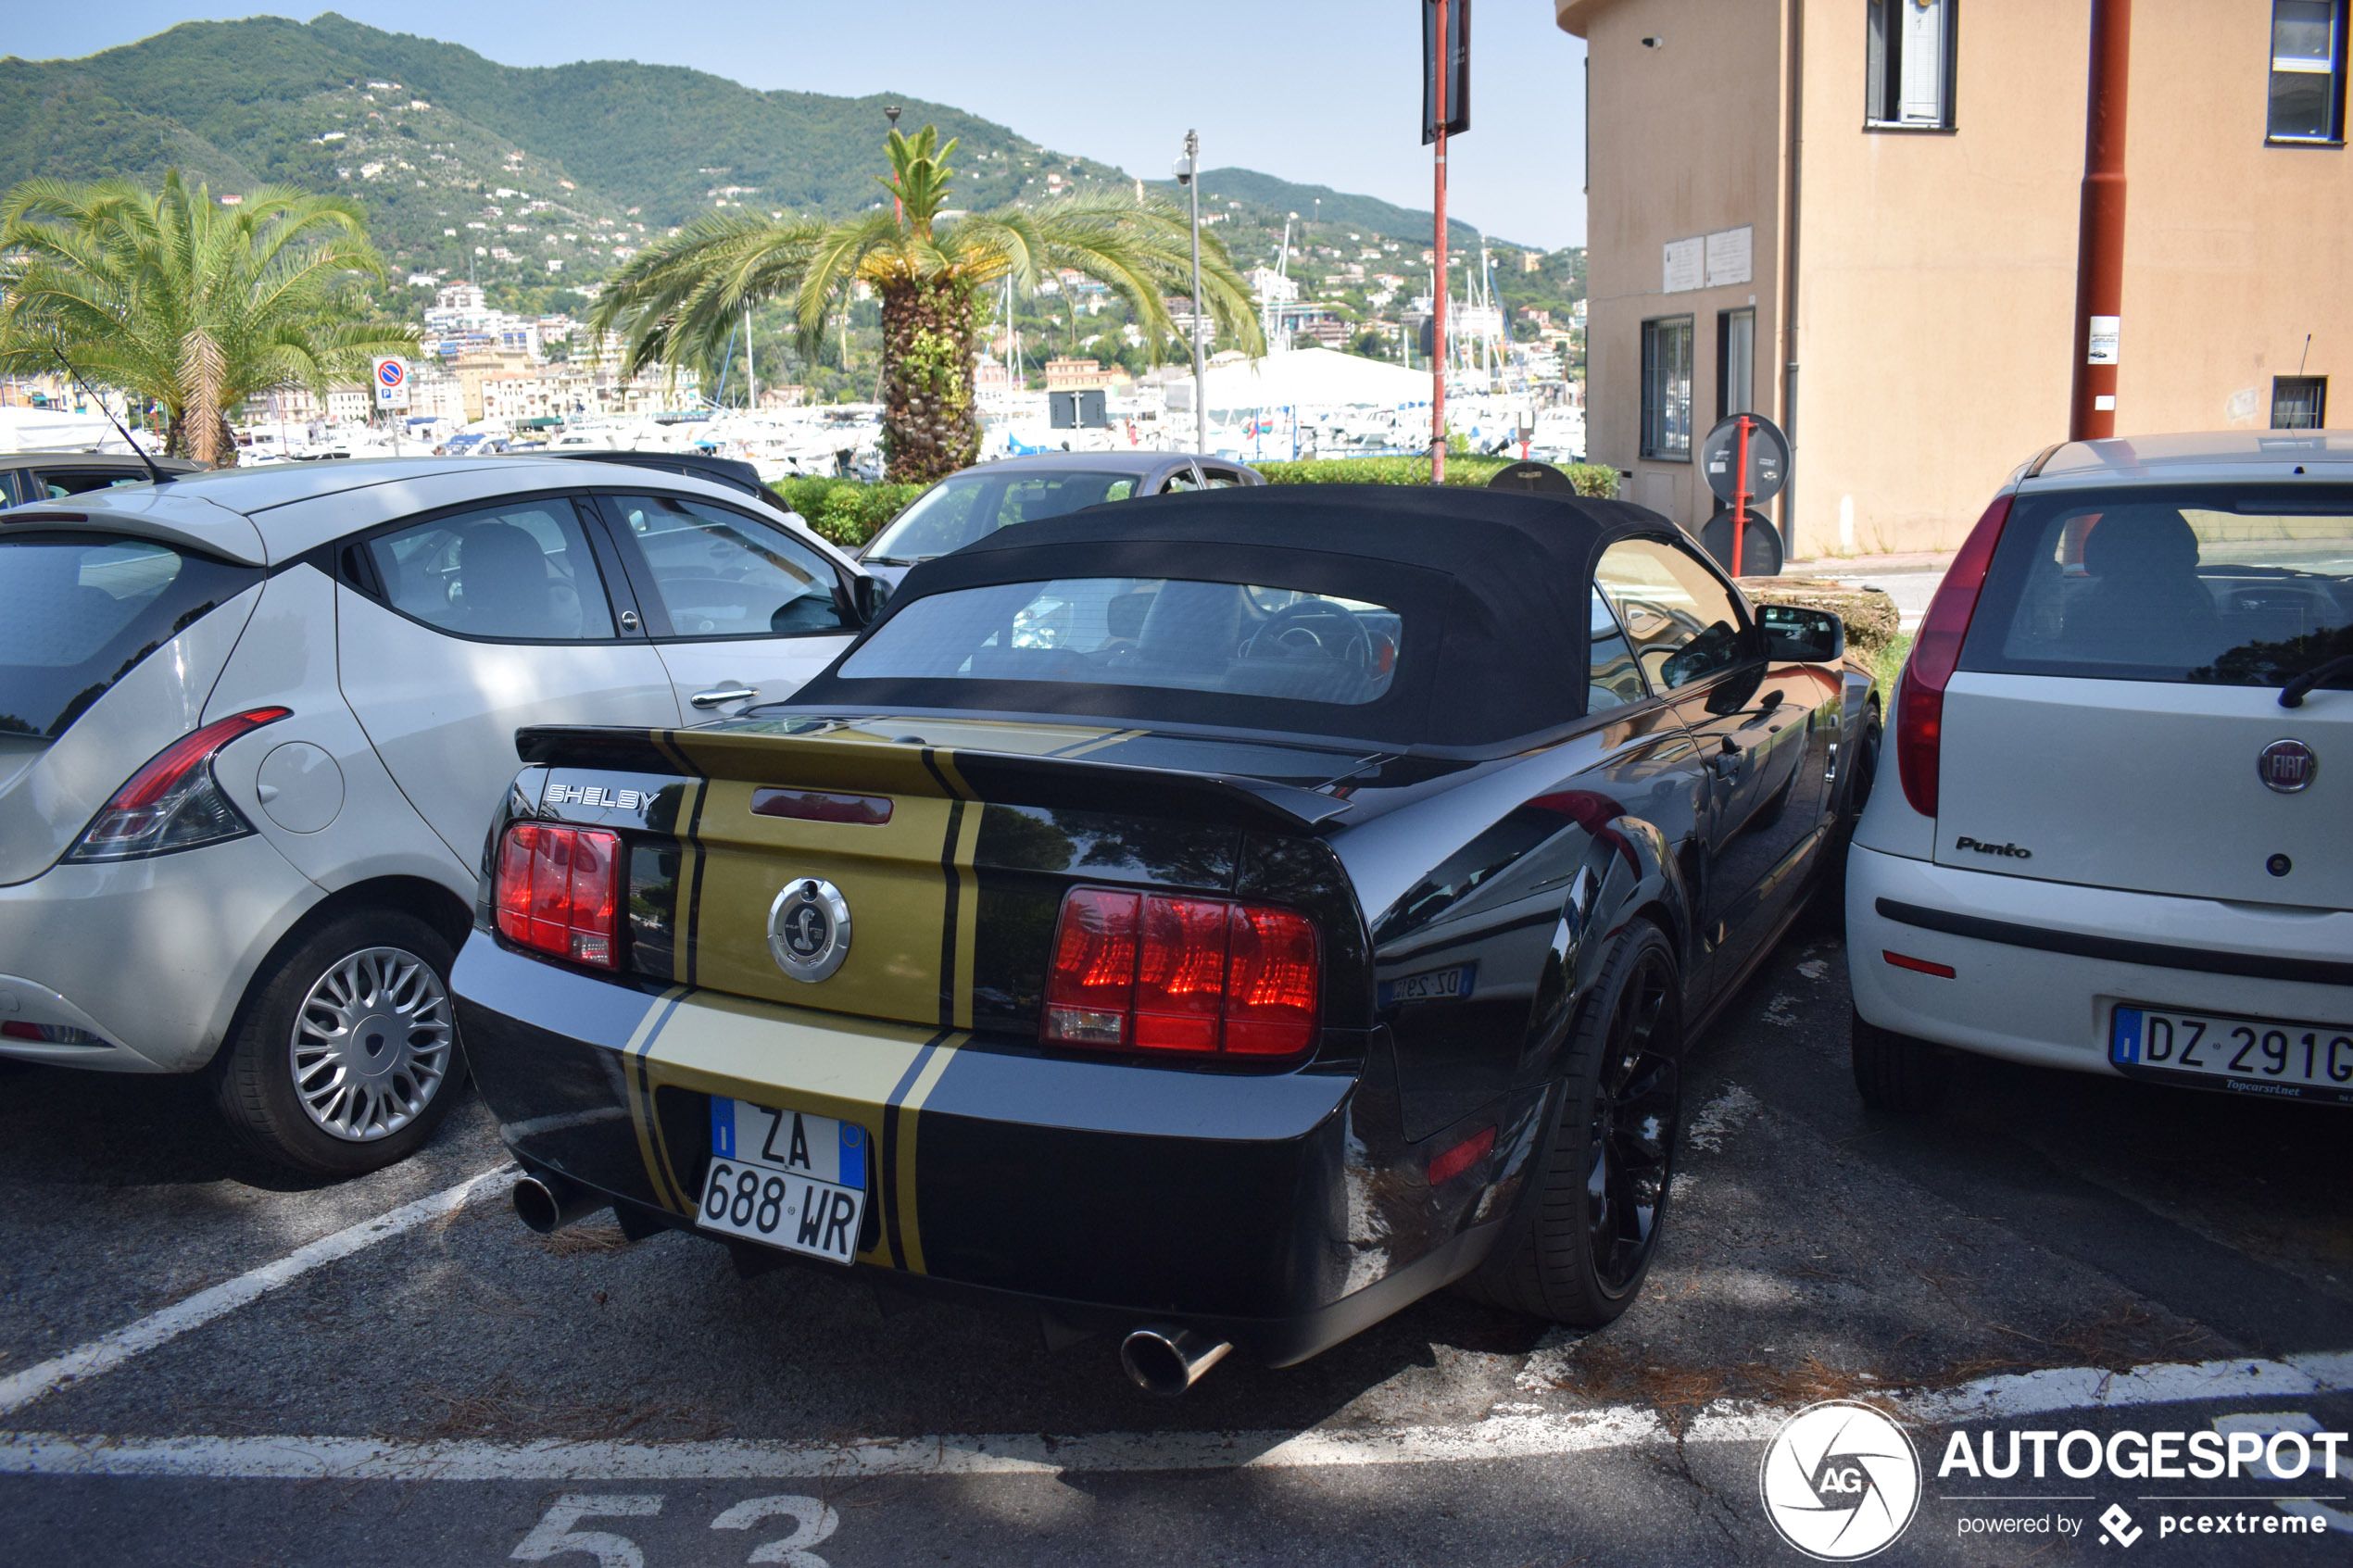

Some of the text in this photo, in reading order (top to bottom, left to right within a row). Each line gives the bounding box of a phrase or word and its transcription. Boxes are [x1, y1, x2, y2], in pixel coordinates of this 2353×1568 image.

[2272, 755, 2305, 779] FIAT
[547, 784, 661, 811] SHELBY
[1956, 835, 2032, 859] Punto
[2147, 1016, 2207, 1067] DZ
[760, 1106, 811, 1170] ZA
[705, 1163, 856, 1256] 688 WR
